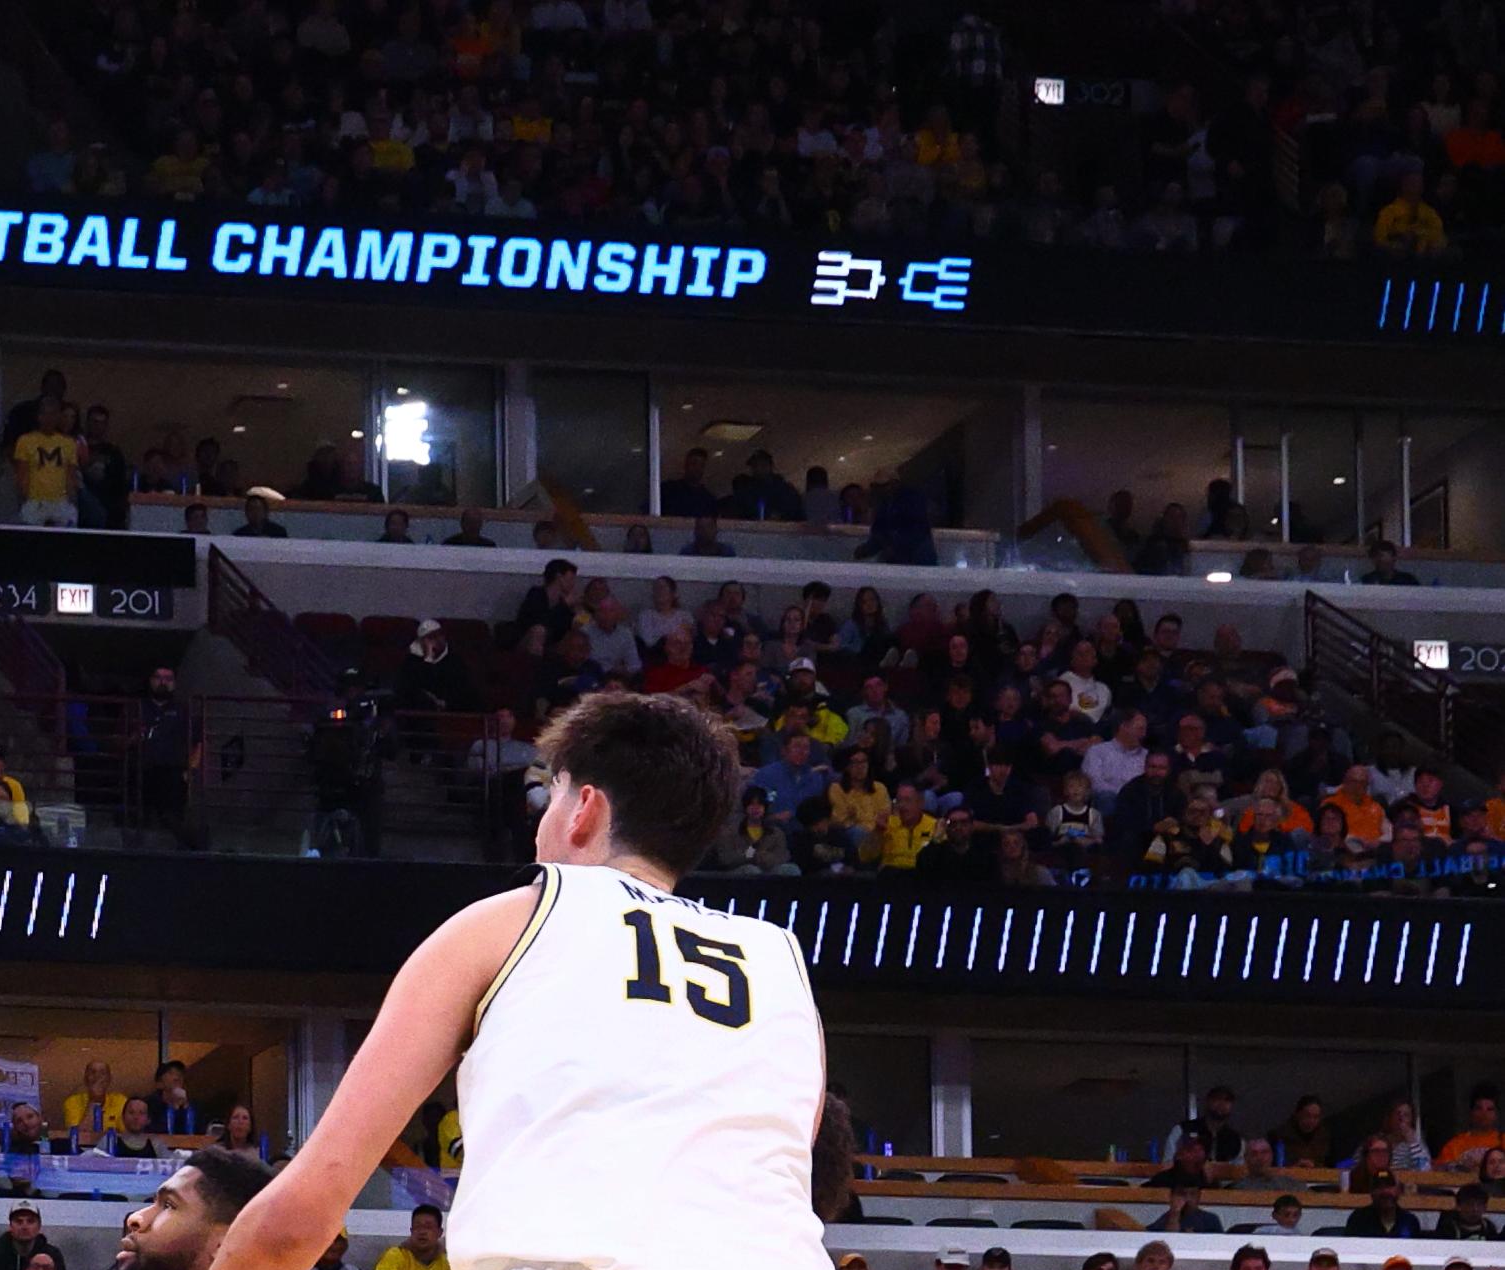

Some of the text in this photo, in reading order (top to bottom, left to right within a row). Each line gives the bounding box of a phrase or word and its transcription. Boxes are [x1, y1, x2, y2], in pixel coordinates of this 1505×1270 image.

[210, 222, 767, 298] CHAMPIONSHIP
[37, 448, 62, 467] M
[61, 589, 90, 607] EXIT
[109, 588, 162, 616] 201
[1456, 645, 1505, 672] 20
[623, 909, 751, 1029] 15
